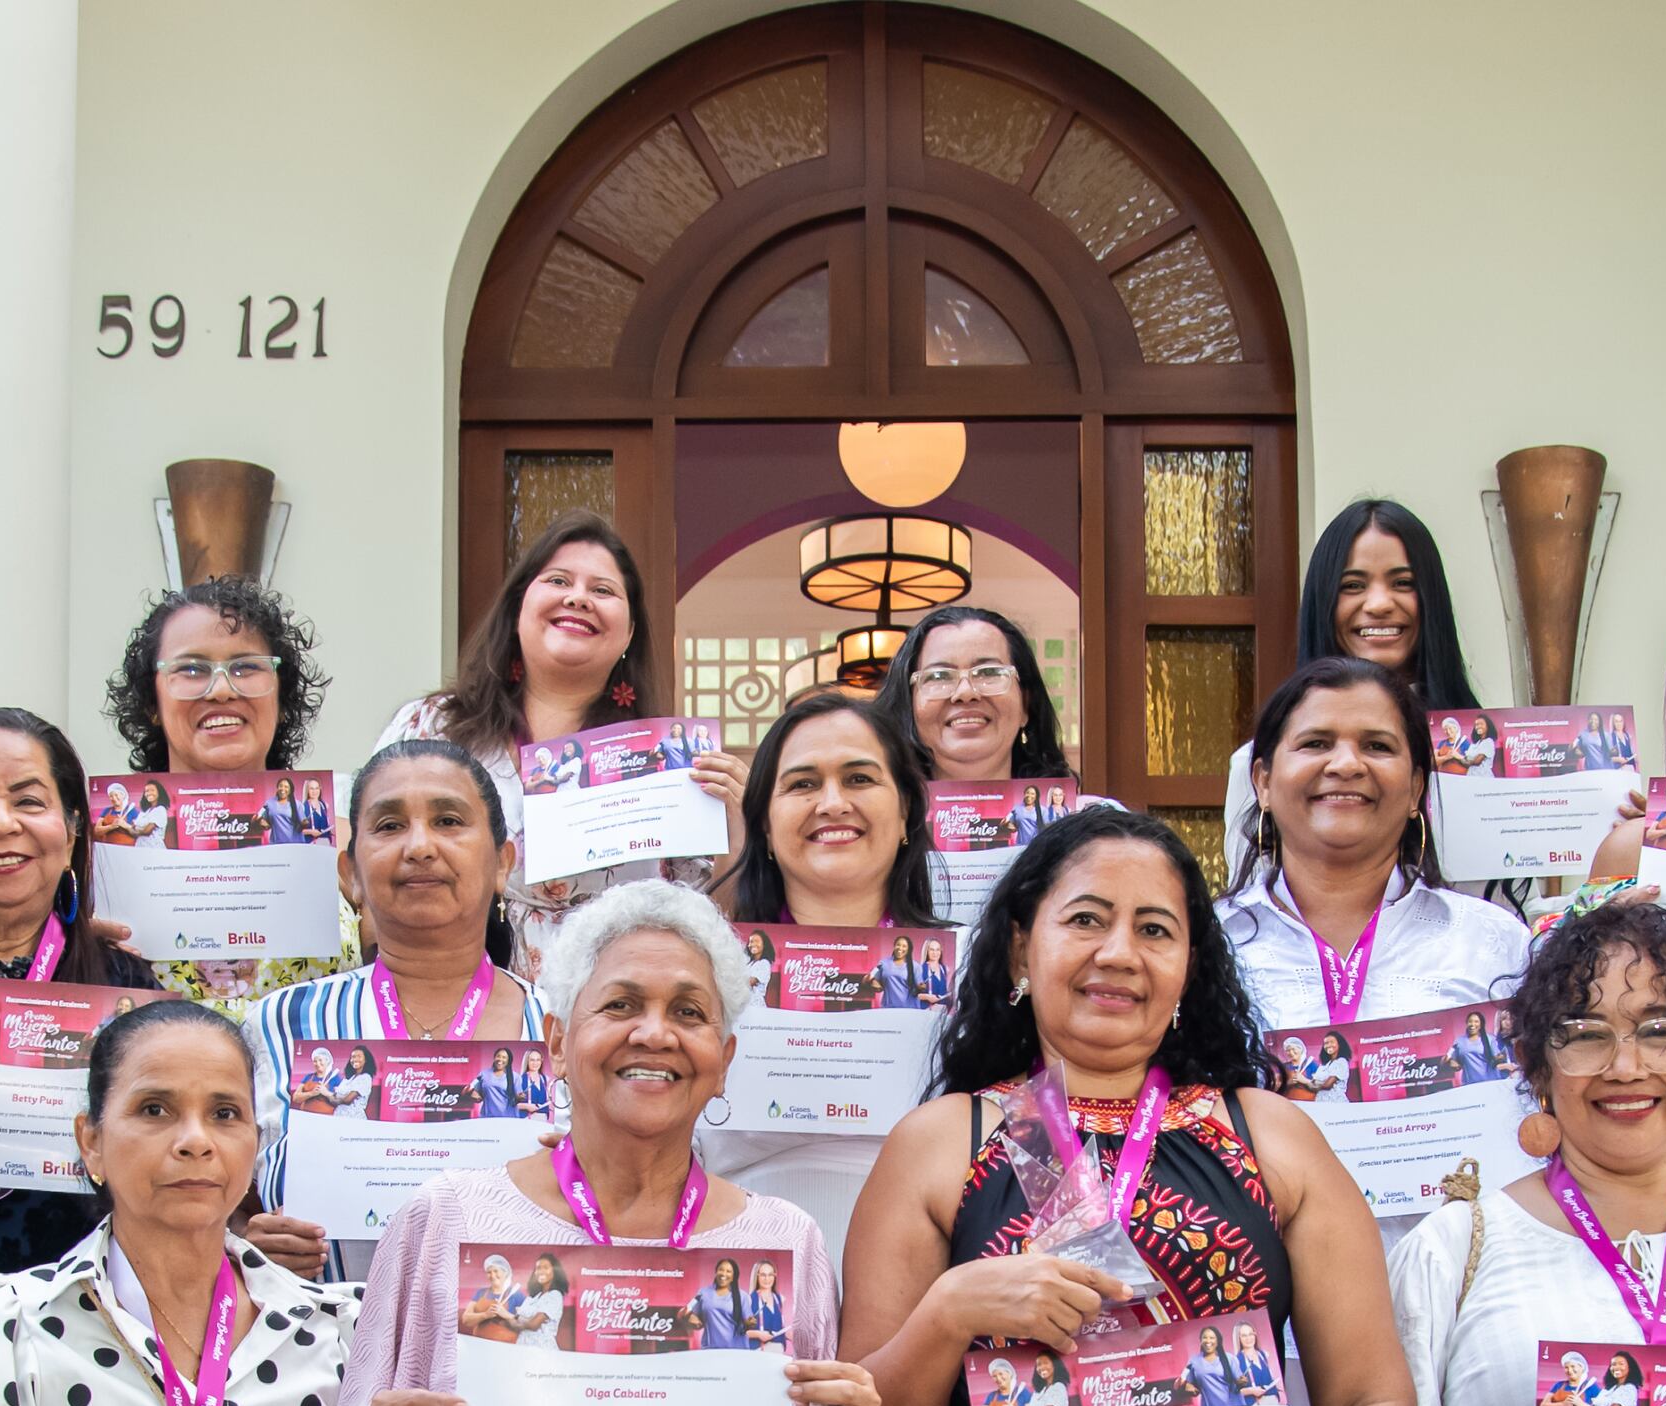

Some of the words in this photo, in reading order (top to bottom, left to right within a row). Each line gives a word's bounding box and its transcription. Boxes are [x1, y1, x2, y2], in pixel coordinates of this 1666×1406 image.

[96, 294, 186, 360] 59
[237, 294, 329, 359] 121
[1505, 736, 1549, 753] Mujeres
[1510, 748, 1565, 764] Brillantes
[179, 804, 230, 823] Mujeres
[935, 809, 981, 827] Mujeres
[185, 818, 249, 835] Brillantes
[940, 822, 998, 838] Brillantes
[629, 837, 661, 851] Brilla
[1549, 850, 1582, 863] Brilla
[228, 932, 266, 945] Brilla
[783, 959, 840, 981] Mujeres
[788, 975, 860, 995] Brillantes
[3, 1013, 61, 1037] Mujeres
[7, 1031, 81, 1053] Brillantes
[1362, 1053, 1416, 1072] Mujeres
[384, 1072, 440, 1093] Mujeres
[1368, 1063, 1438, 1086] Brillantes
[11, 1093, 38, 1105] Betty
[38, 1095, 64, 1107] Pupo
[389, 1088, 459, 1106] Brillantes
[826, 1103, 868, 1118] Brilla
[603, 1282, 641, 1297] Premio
[579, 1289, 649, 1316] Mujeres
[585, 1310, 674, 1333] Brillantes
[1101, 1366, 1136, 1381] Premio
[585, 1387, 611, 1400] Olga
[613, 1388, 667, 1399] Caballero
[1083, 1375, 1145, 1399] Mujeres
